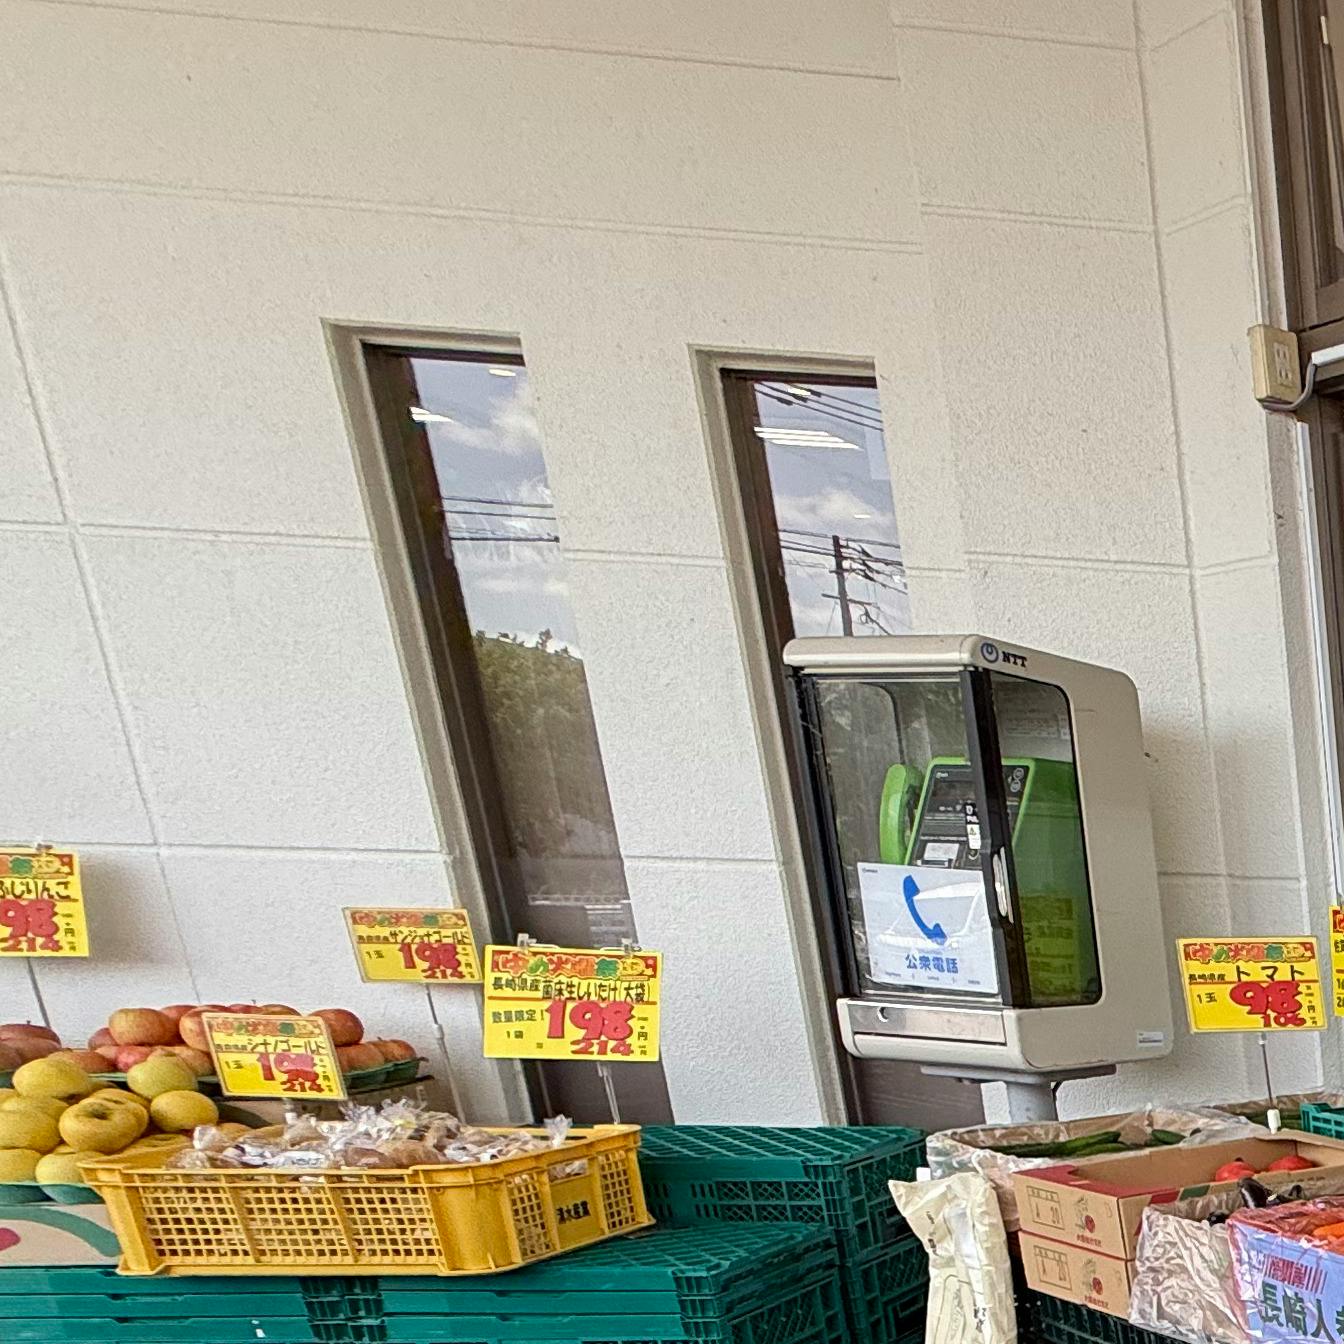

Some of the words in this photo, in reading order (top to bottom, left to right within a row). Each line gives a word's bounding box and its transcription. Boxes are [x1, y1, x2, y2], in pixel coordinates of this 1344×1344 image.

[1002, 651, 1027, 668] NTT
[905, 953, 958, 974] 公衆電話
[1236, 965, 1305, 982] トマト
[492, 977, 541, 992] 長崎県産
[1229, 981, 1303, 1015] 98
[545, 1000, 636, 1040] 198
[570, 1039, 634, 1056] 214
